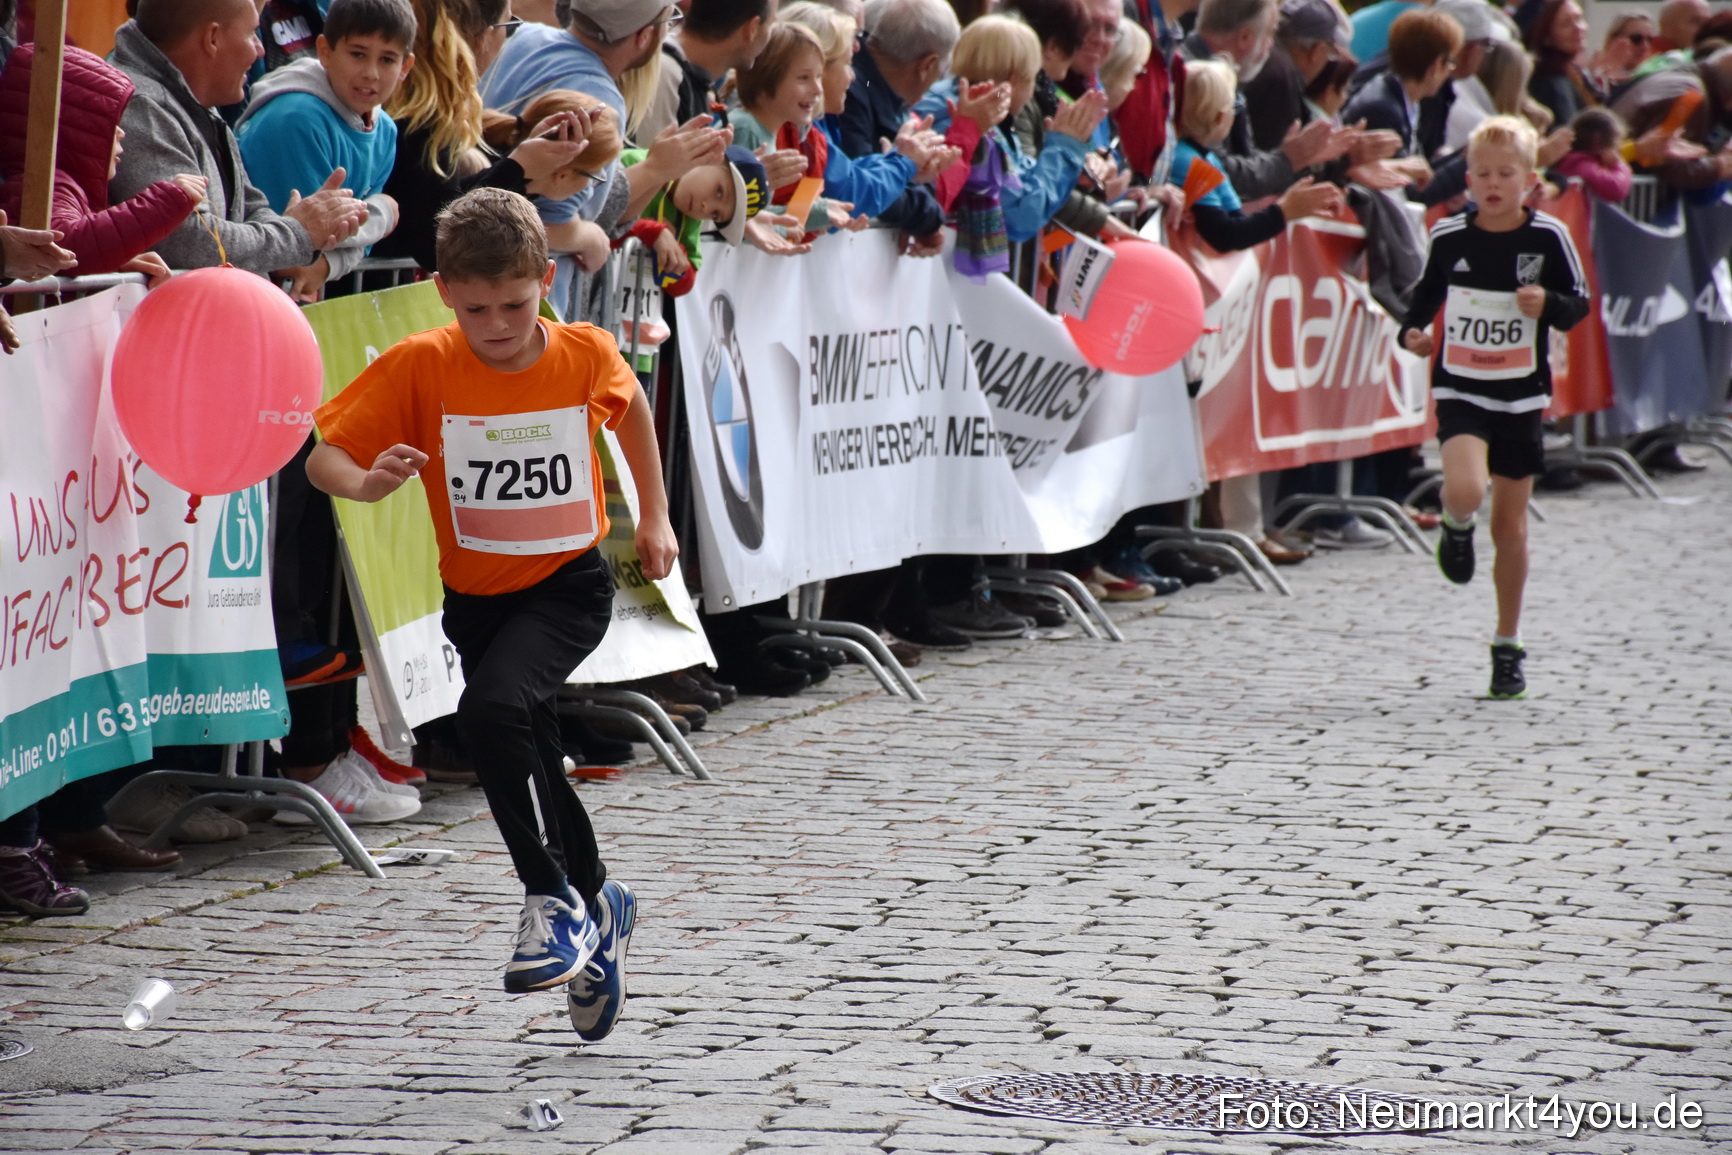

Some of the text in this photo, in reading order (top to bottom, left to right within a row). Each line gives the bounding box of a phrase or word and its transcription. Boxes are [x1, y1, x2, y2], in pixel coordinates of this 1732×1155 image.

[1458, 316, 1522, 346] 7056
[258, 395, 315, 425] RÖD
[501, 424, 552, 440] BOCK
[468, 453, 572, 500] 7250
